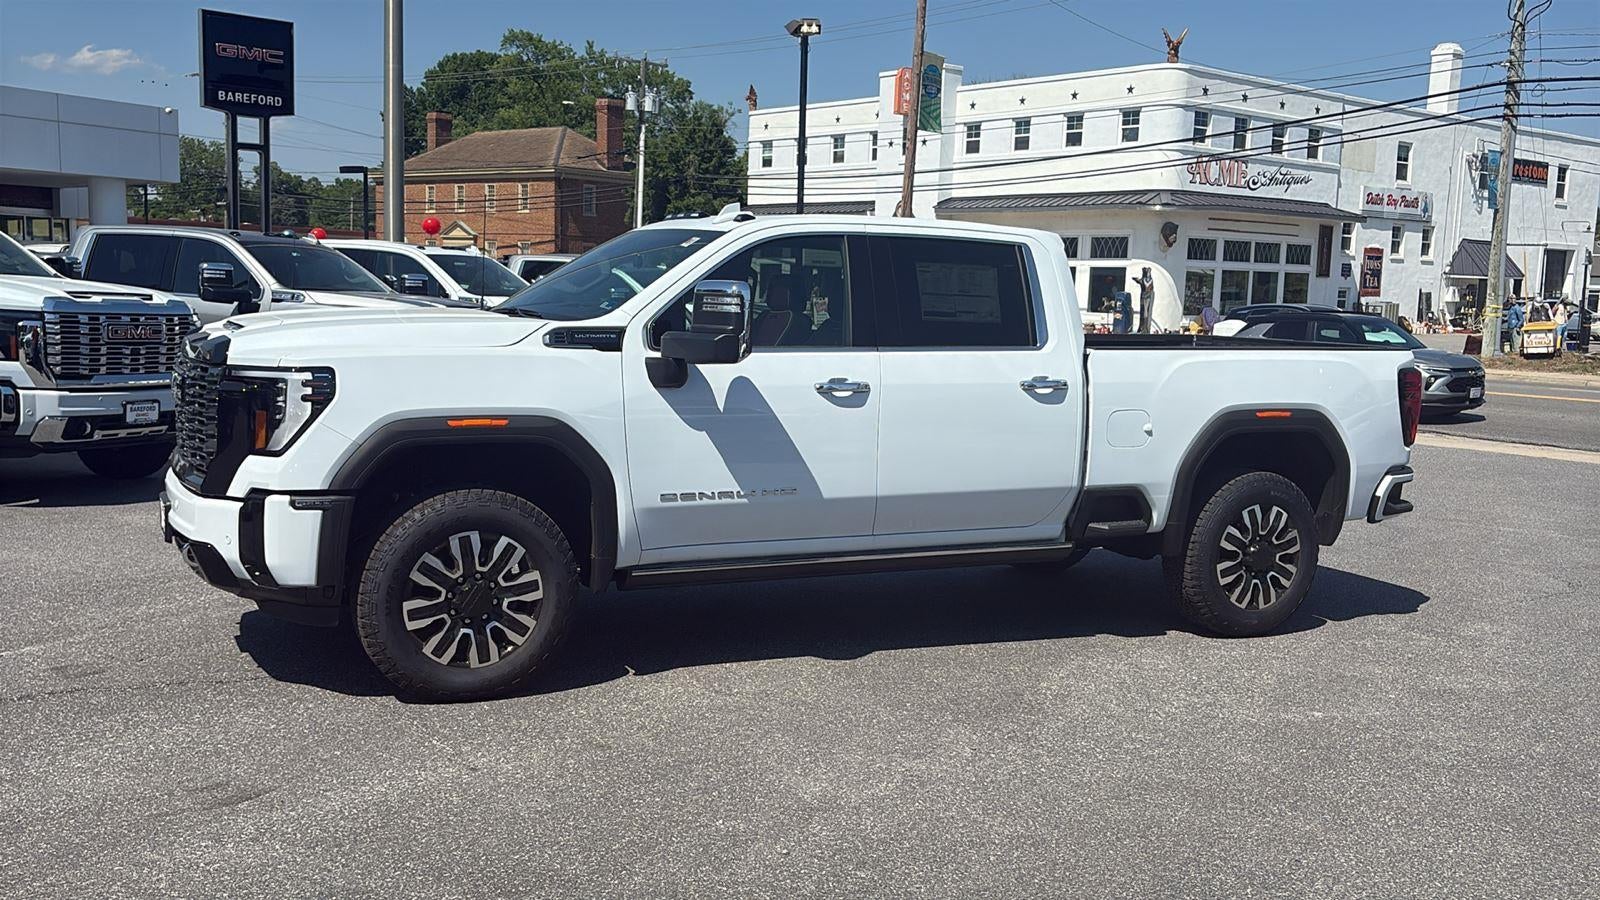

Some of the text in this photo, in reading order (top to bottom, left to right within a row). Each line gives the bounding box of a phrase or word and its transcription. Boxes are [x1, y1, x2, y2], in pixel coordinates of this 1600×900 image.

[215, 42, 284, 64] GMC
[218, 90, 282, 107] BAREFORD
[902, 68, 911, 112] ACME
[1187, 154, 1313, 193] ACME Antiques
[1366, 192, 1420, 210] Dutch Boy Paints
[1365, 275, 1378, 287] TEA
[108, 325, 163, 339] GMC
[660, 491, 757, 503] DENALI
